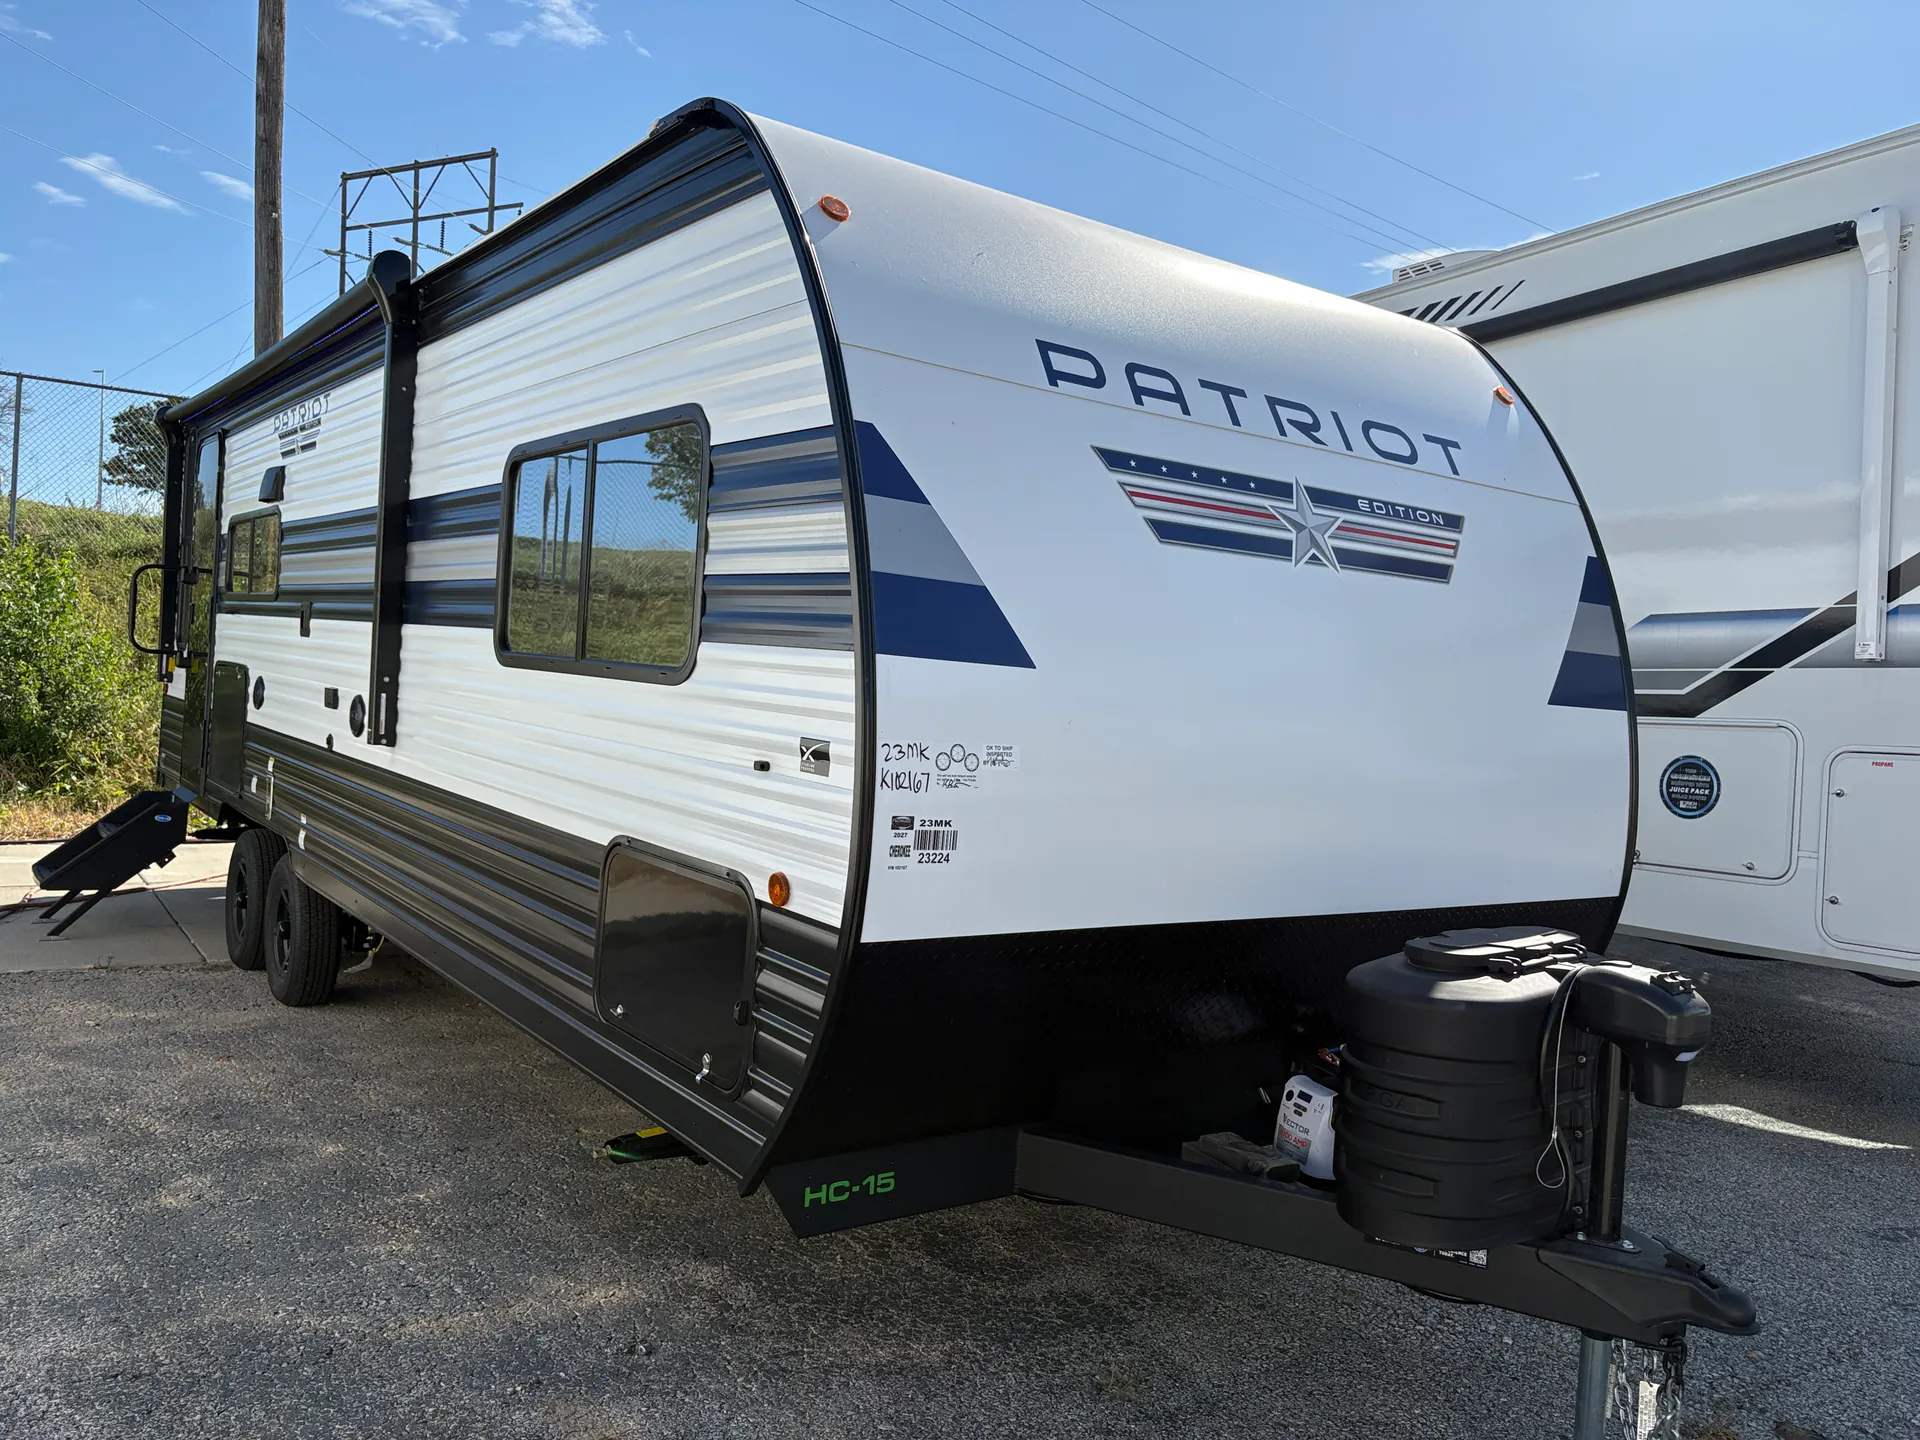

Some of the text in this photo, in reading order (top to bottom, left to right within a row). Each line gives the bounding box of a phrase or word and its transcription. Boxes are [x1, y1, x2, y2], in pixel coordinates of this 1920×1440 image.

[273, 393, 331, 434] PATRIOT
[1035, 338, 1462, 476] PATRIOT
[1357, 498, 1444, 526] EDITION
[1690, 787, 1710, 795] PACK
[919, 819, 953, 827] 23MK
[889, 845, 911, 857] CHEROKEE
[917, 853, 950, 864] 23224
[1283, 1112, 1310, 1137] VECTOR
[804, 1171, 895, 1208] HC-15
